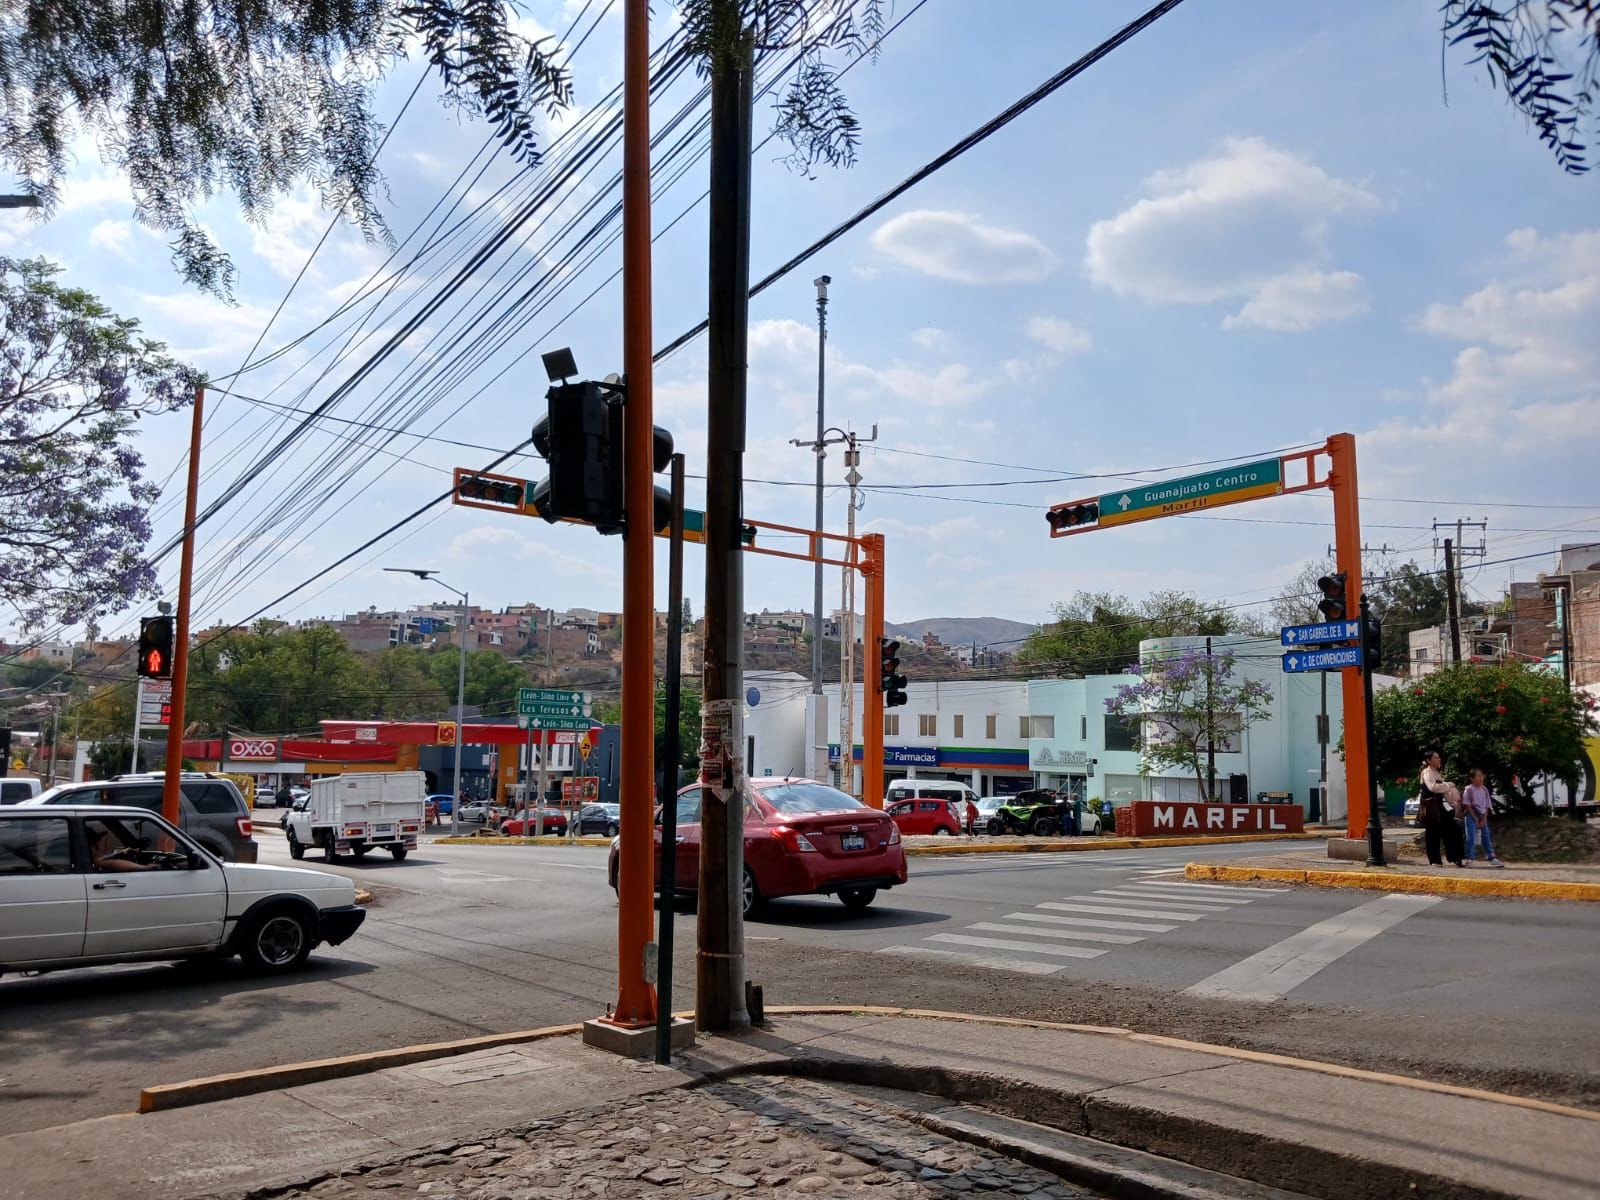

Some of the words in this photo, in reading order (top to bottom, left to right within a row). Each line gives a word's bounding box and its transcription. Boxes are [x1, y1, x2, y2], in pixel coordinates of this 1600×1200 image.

[1145, 482, 1210, 501] Guanajuato
[1216, 472, 1257, 488] Centro
[1162, 498, 1208, 513] Marfil
[1299, 629, 1309, 641] SAN
[1309, 626, 1329, 640] GABRIEL
[1330, 625, 1337, 638] DE
[1302, 656, 1308, 667] C.
[1308, 655, 1316, 667] DE
[1316, 651, 1357, 666] CONVENCIONES
[522, 703, 536, 713] Las
[540, 705, 569, 715] Teresas
[231, 740, 276, 758] OXXO
[895, 751, 937, 762] Farmacias
[1153, 806, 1287, 830] MARFIL
